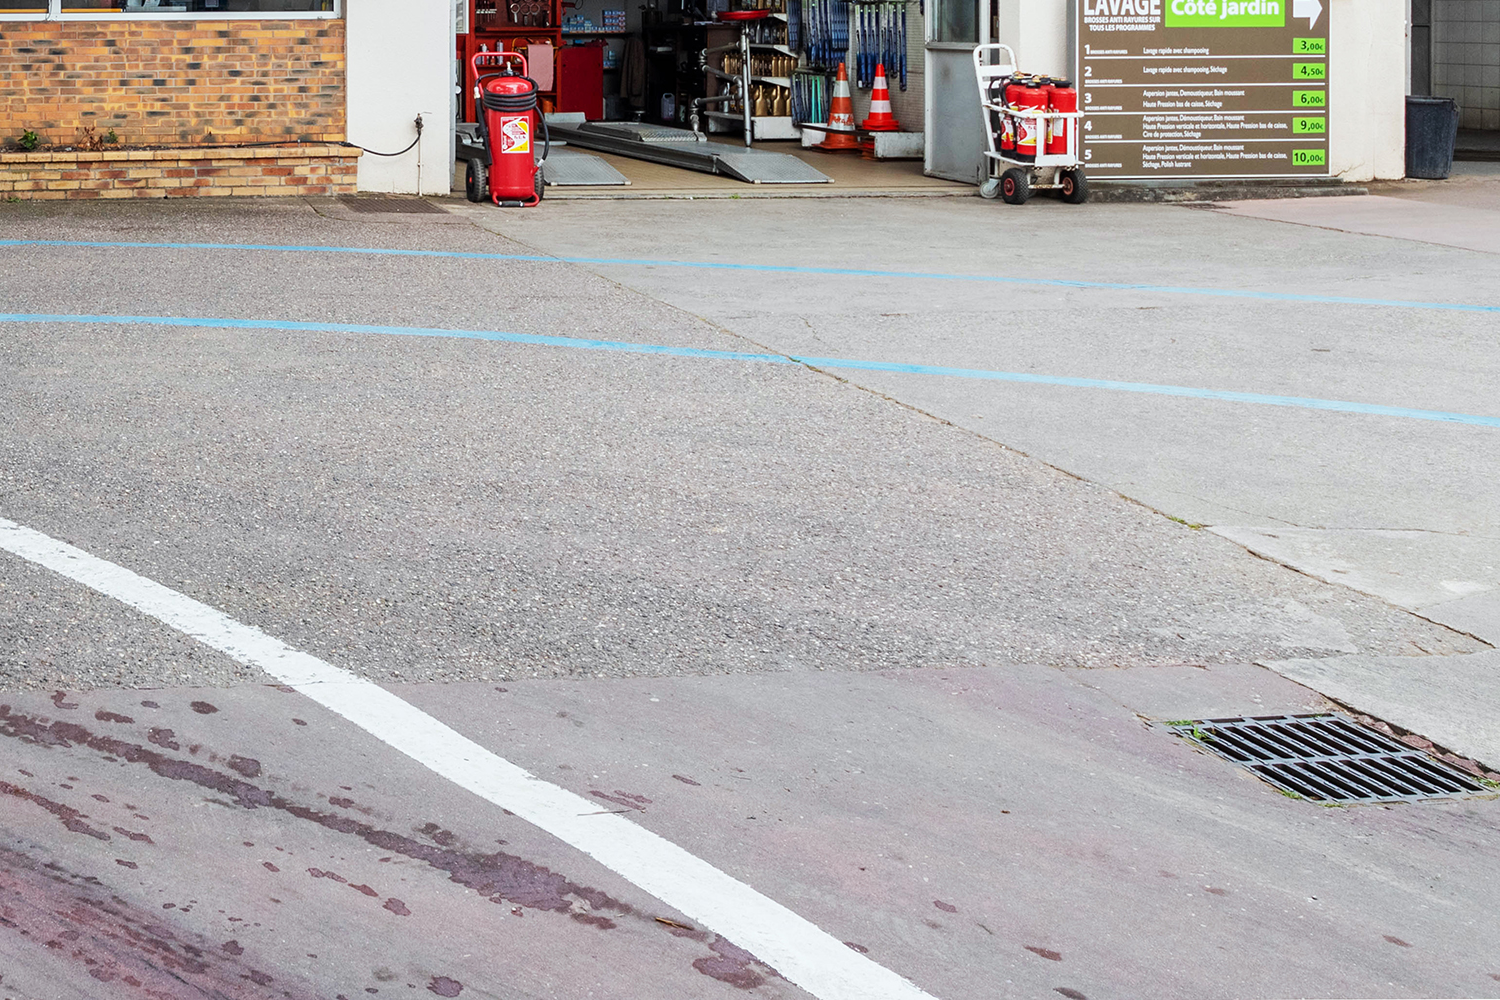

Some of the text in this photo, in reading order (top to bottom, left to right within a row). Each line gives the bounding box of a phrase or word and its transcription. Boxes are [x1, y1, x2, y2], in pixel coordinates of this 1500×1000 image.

[1084, 44, 1090, 55] 1
[1300, 40, 1323, 51] 3,00€
[1084, 66, 1092, 77] 2
[1301, 66, 1323, 76] 4,50€
[1084, 93, 1092, 103] 3
[1301, 94, 1323, 104] 6,00€
[1084, 120, 1092, 131] 4
[1300, 120, 1323, 131] 9,00€
[1084, 149, 1092, 160] 5
[1294, 152, 1323, 163] 10,00€
